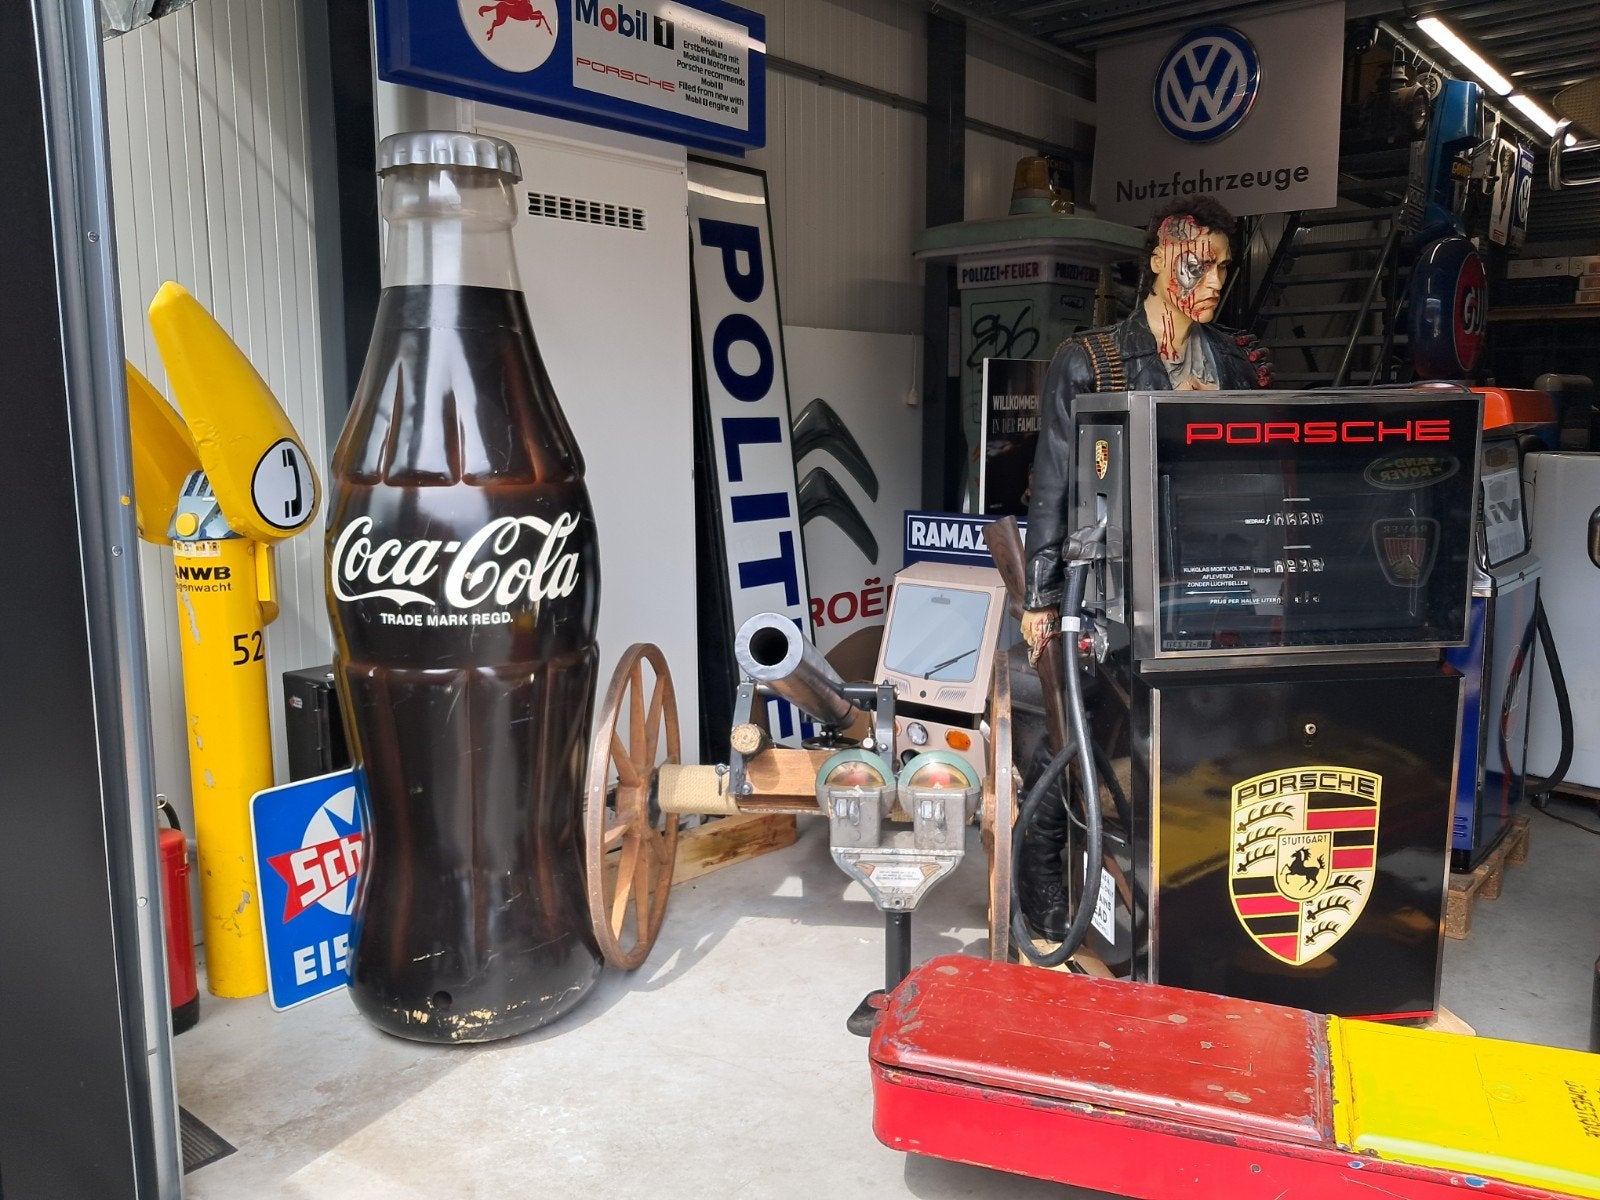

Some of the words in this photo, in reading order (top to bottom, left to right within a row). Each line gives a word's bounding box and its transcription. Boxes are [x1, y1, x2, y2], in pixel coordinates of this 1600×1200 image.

[575, 0, 648, 42] Mobil
[655, 16, 674, 50] 1
[701, 36, 717, 47] Mobil
[683, 51, 700, 63] Mobil
[728, 56, 740, 65] mit
[576, 57, 675, 92] PORSCHE
[677, 59, 703, 75] Porsche
[704, 67, 746, 87] recommends
[701, 78, 718, 89] Mobil
[678, 81, 696, 93] Filled
[697, 86, 714, 97] from
[714, 91, 728, 101] new
[729, 95, 744, 106] with
[685, 93, 702, 105] Mobil
[708, 101, 730, 112] engine
[731, 106, 739, 115] oil
[1116, 165, 1309, 202] Nutzfahrzeuge
[1186, 419, 1451, 445] PORSCHE
[699, 218, 815, 740] POLITE
[332, 512, 580, 608] Coca-Cola
[175, 565, 231, 581] NWB
[1187, 580, 1210, 588] ZONDER
[176, 582, 232, 593] genwacht
[380, 612, 423, 626] TRADE
[427, 612, 468, 626] MARK
[472, 611, 514, 625] REGD.
[1237, 772, 1376, 807] PORSCHE
[1281, 834, 1328, 846] STUTTGART
[294, 933, 349, 986] EIS
